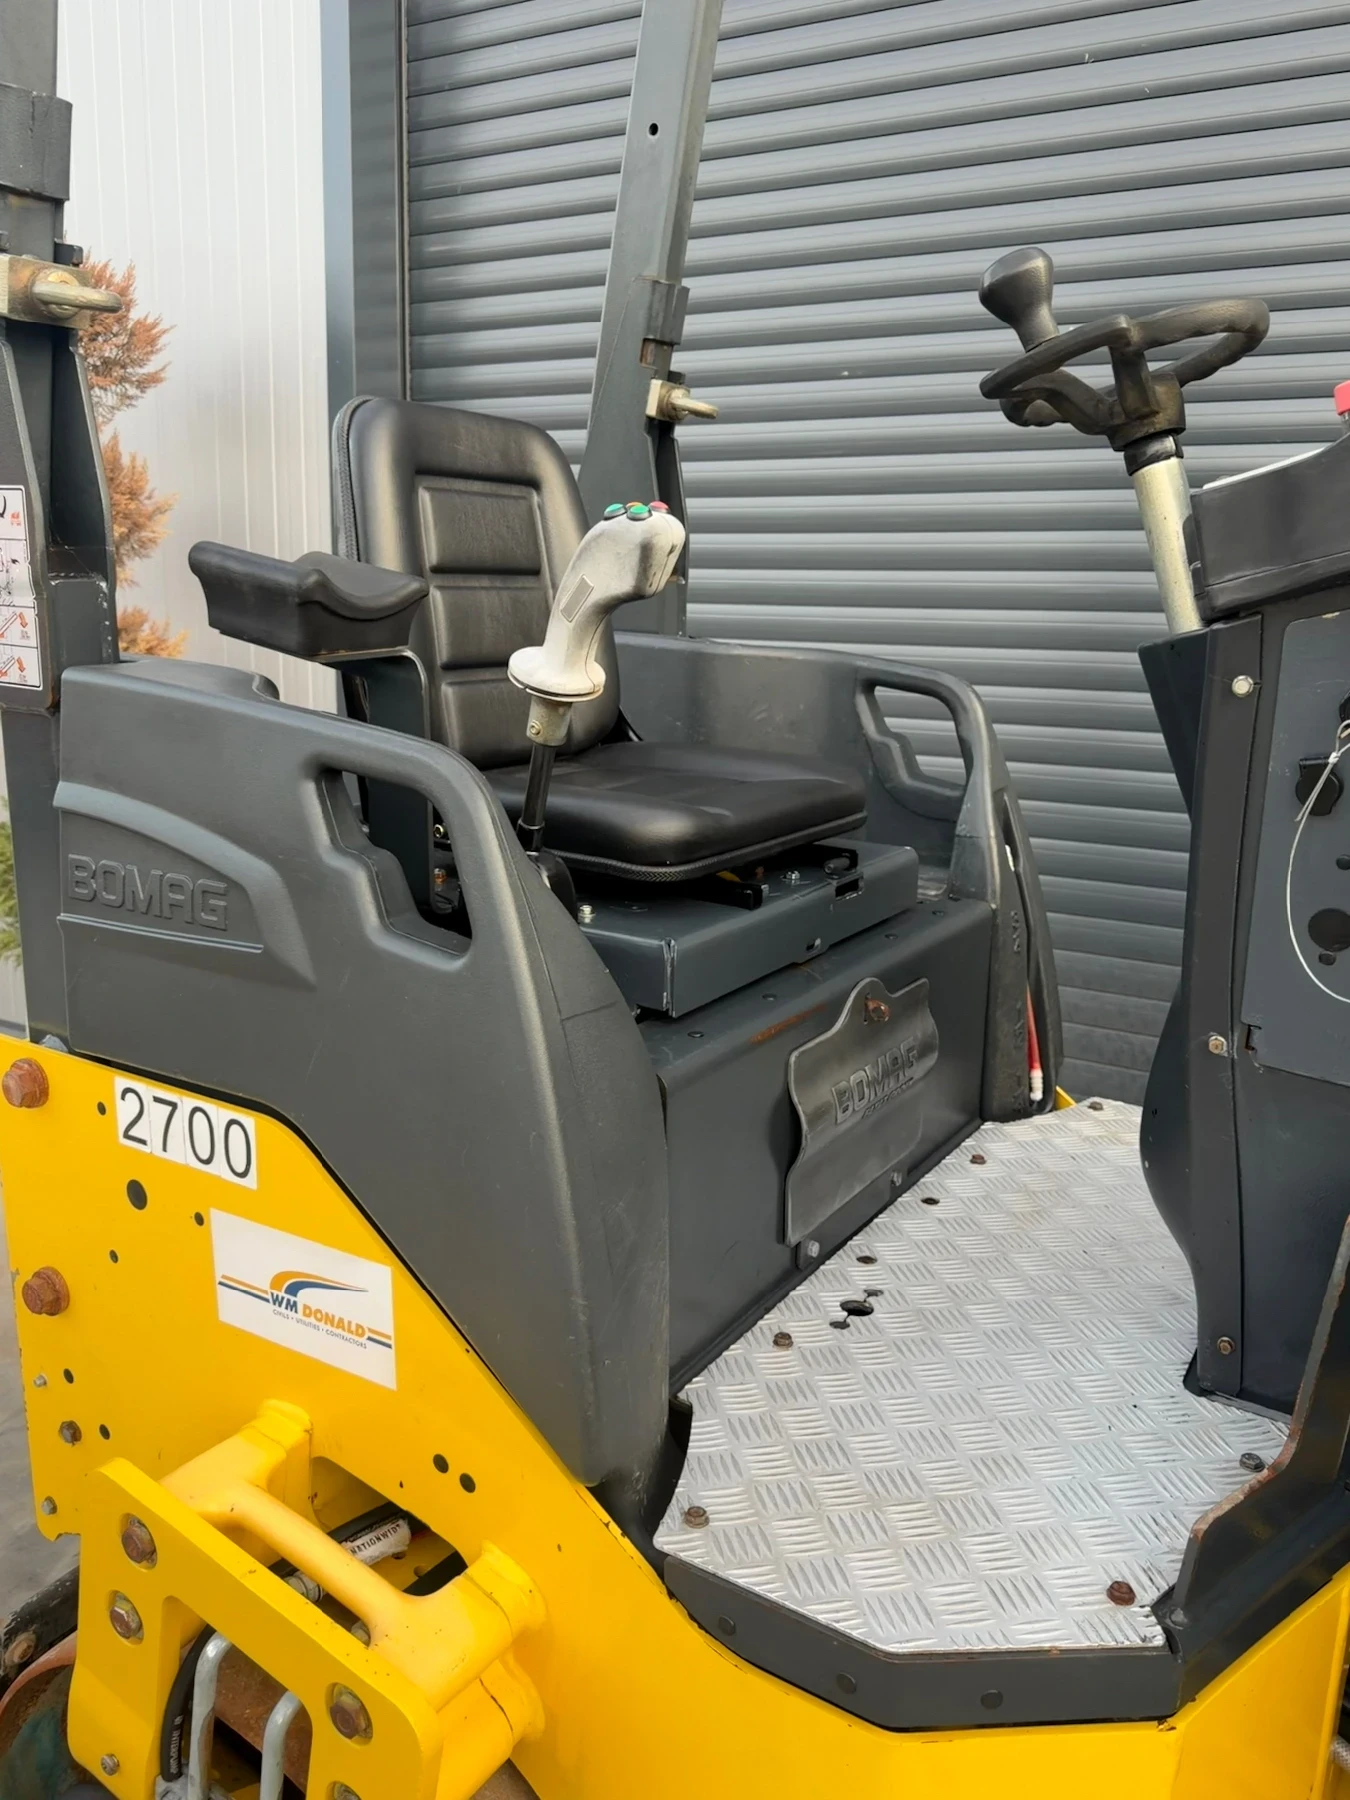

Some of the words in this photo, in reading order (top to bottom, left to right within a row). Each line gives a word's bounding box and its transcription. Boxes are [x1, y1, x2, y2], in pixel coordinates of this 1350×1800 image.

[68, 854, 228, 931] BOMAG
[832, 1037, 917, 1124] BOMAG
[120, 1087, 252, 1179] 2700
[270, 1291, 298, 1314] WM
[302, 1303, 366, 1338] DONALD
[272, 1308, 290, 1320] CIVILS
[295, 1317, 320, 1332] UTILITIES
[325, 1328, 367, 1350] CONTRACTORS
